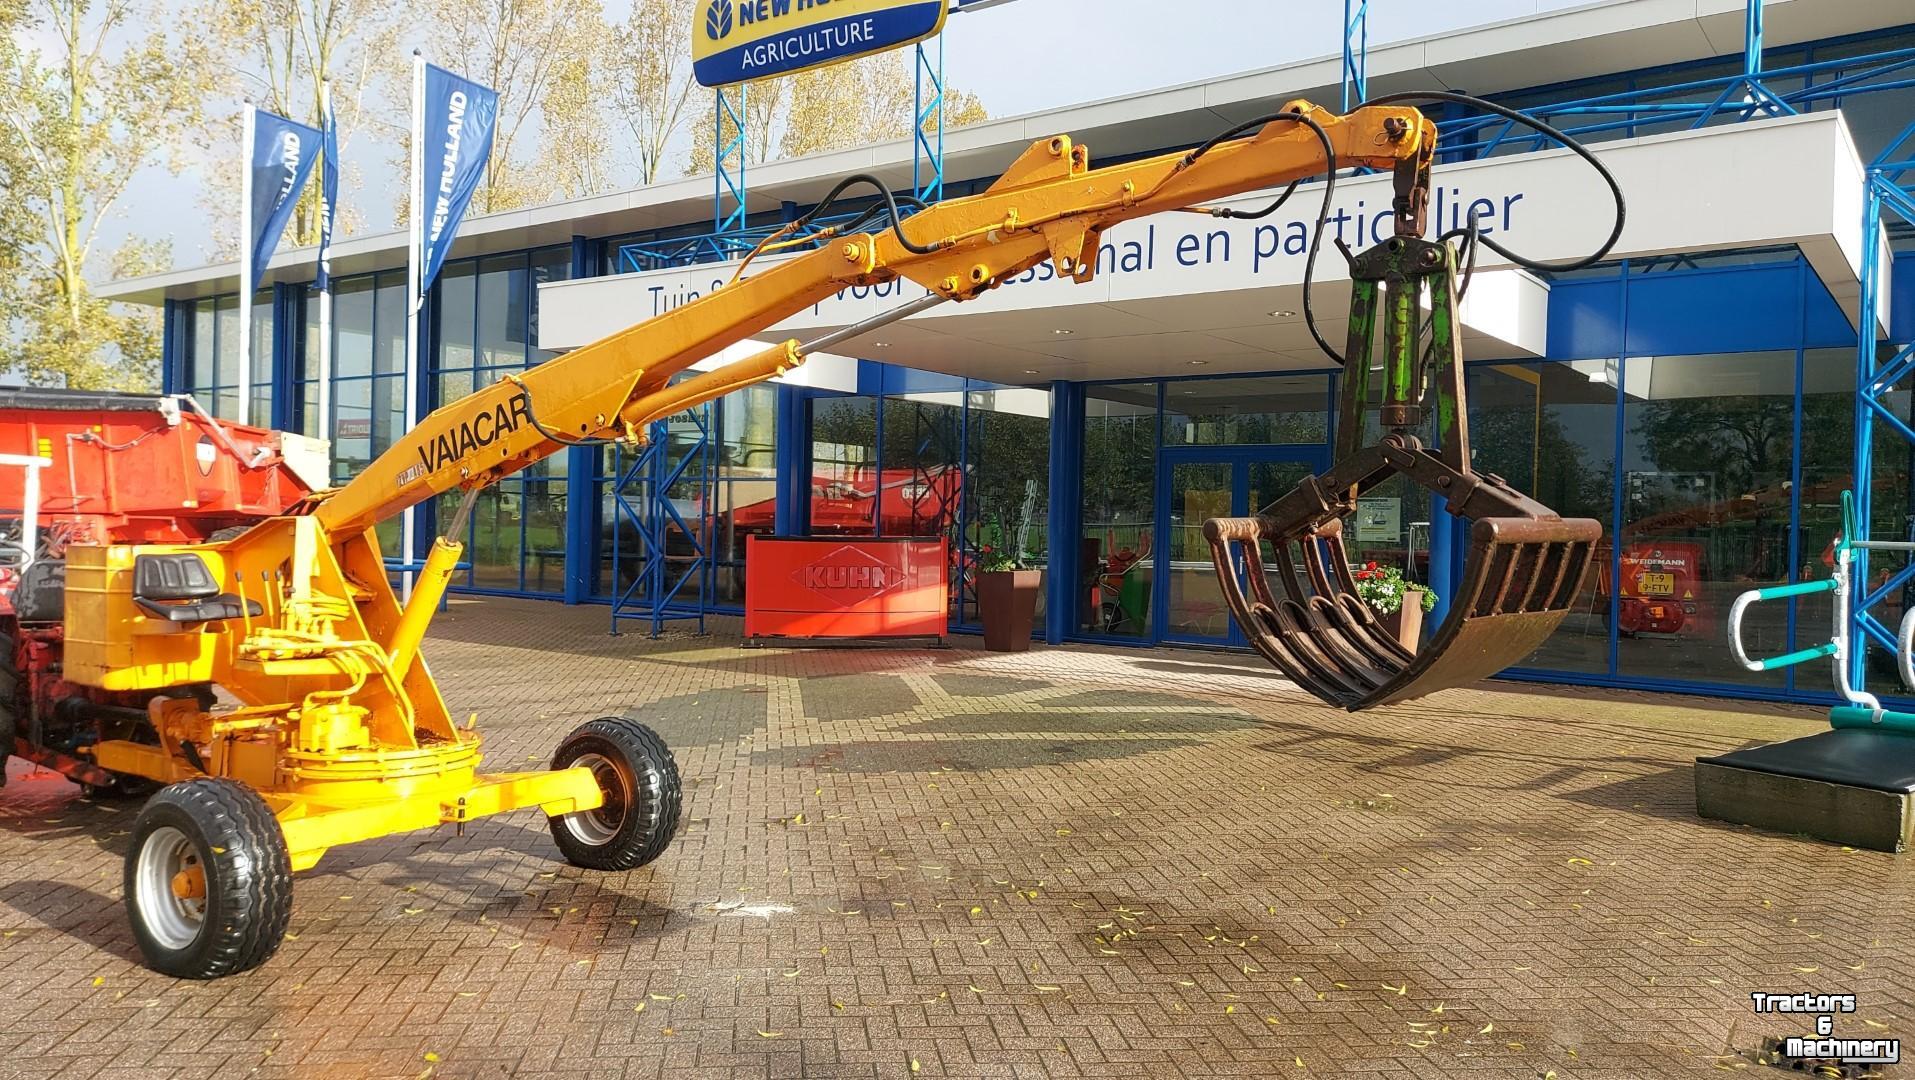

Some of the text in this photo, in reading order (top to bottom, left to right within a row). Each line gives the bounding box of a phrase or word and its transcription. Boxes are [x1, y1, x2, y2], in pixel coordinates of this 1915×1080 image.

[739, 0, 791, 26] NEW
[742, 19, 874, 69] AGRICULTURE
[1176, 229, 1231, 266] en
[418, 393, 532, 474] VAIACAR
[806, 566, 892, 588] KUHN
